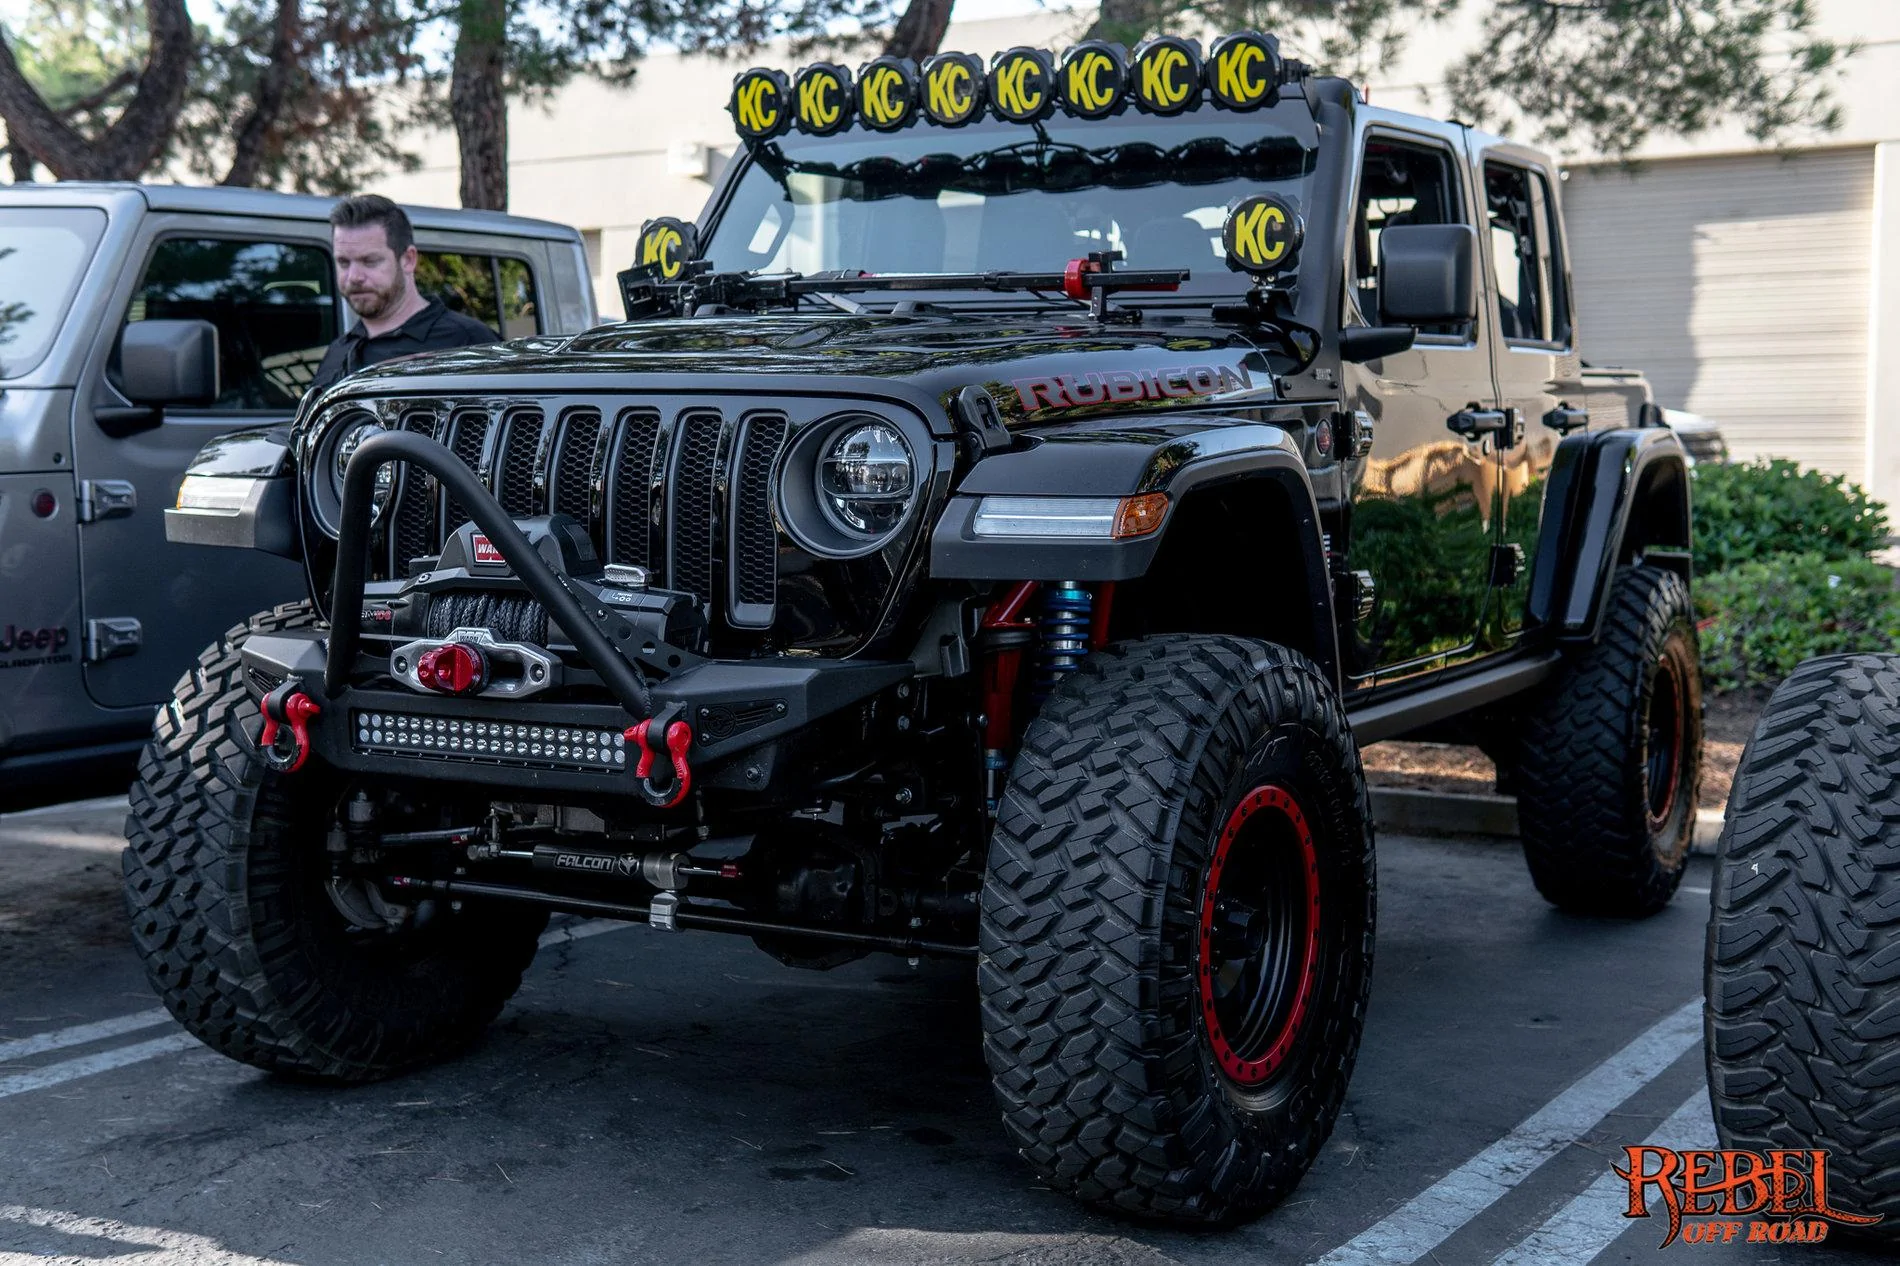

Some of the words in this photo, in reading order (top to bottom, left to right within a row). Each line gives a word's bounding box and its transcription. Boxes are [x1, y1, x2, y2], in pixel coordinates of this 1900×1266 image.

[863, 68, 904, 123] KC
[929, 63, 971, 118] KC
[997, 59, 1041, 114] KC
[1068, 53, 1114, 111] KC
[1142, 47, 1188, 107] KC
[1218, 42, 1266, 103] KC
[737, 77, 777, 132] KC
[799, 73, 839, 128] KC
[643, 226, 682, 278] KC
[1235, 202, 1283, 263] KC
[1011, 362, 1253, 410] RUBICON
[556, 854, 612, 870] FALCON
